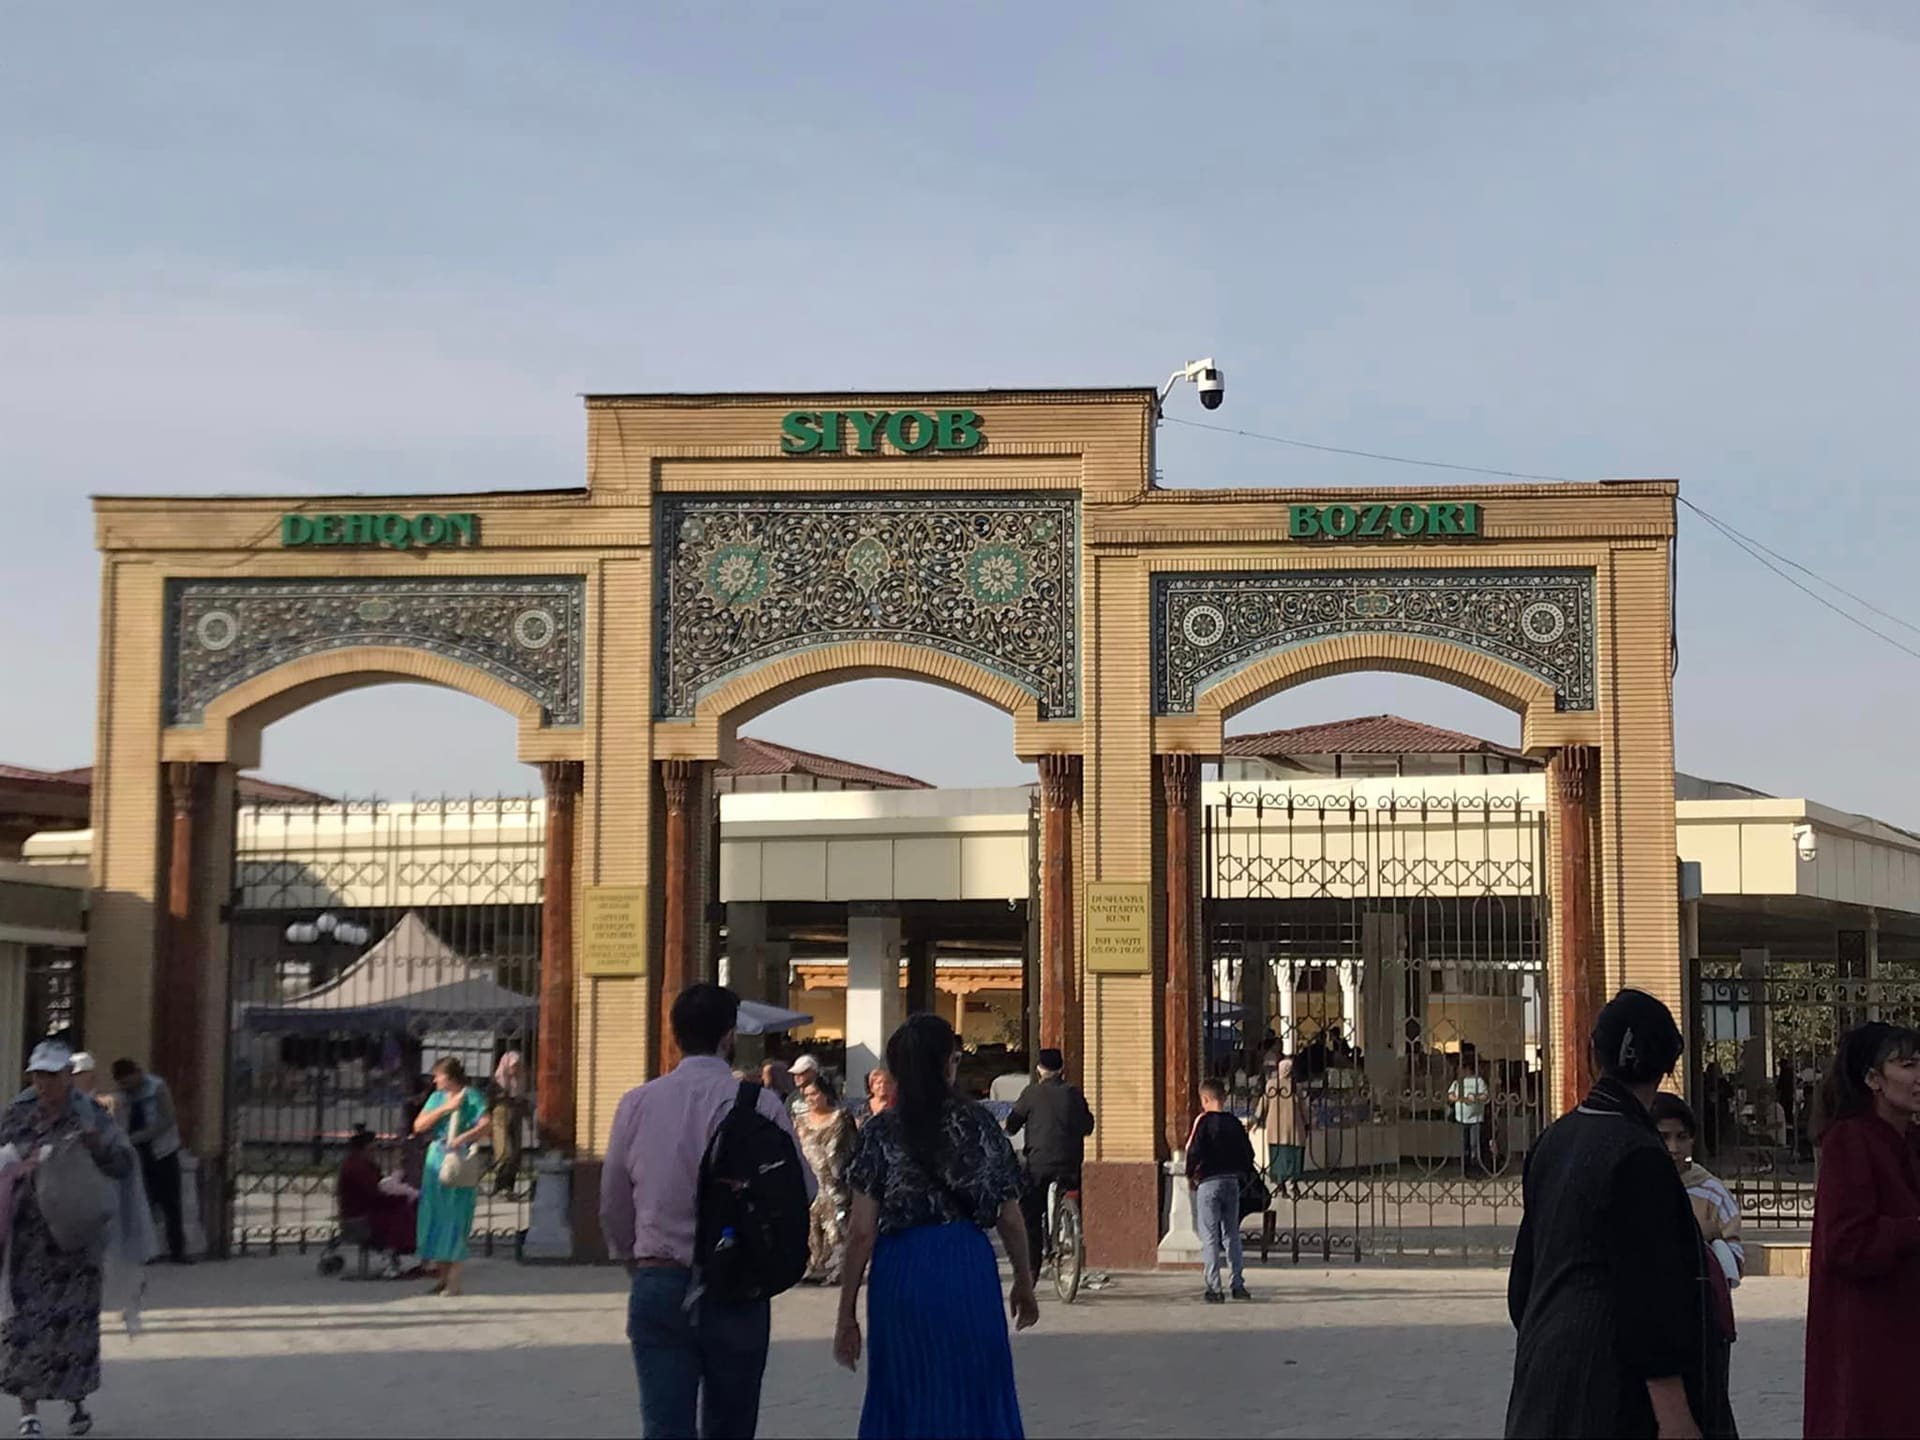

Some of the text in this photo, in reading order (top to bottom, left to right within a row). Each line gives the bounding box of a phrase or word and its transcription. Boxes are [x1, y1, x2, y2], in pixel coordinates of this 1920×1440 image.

[781, 409, 983, 452] SIYOB
[282, 513, 474, 549] DEHQON
[1288, 503, 1479, 536] BOZORI
